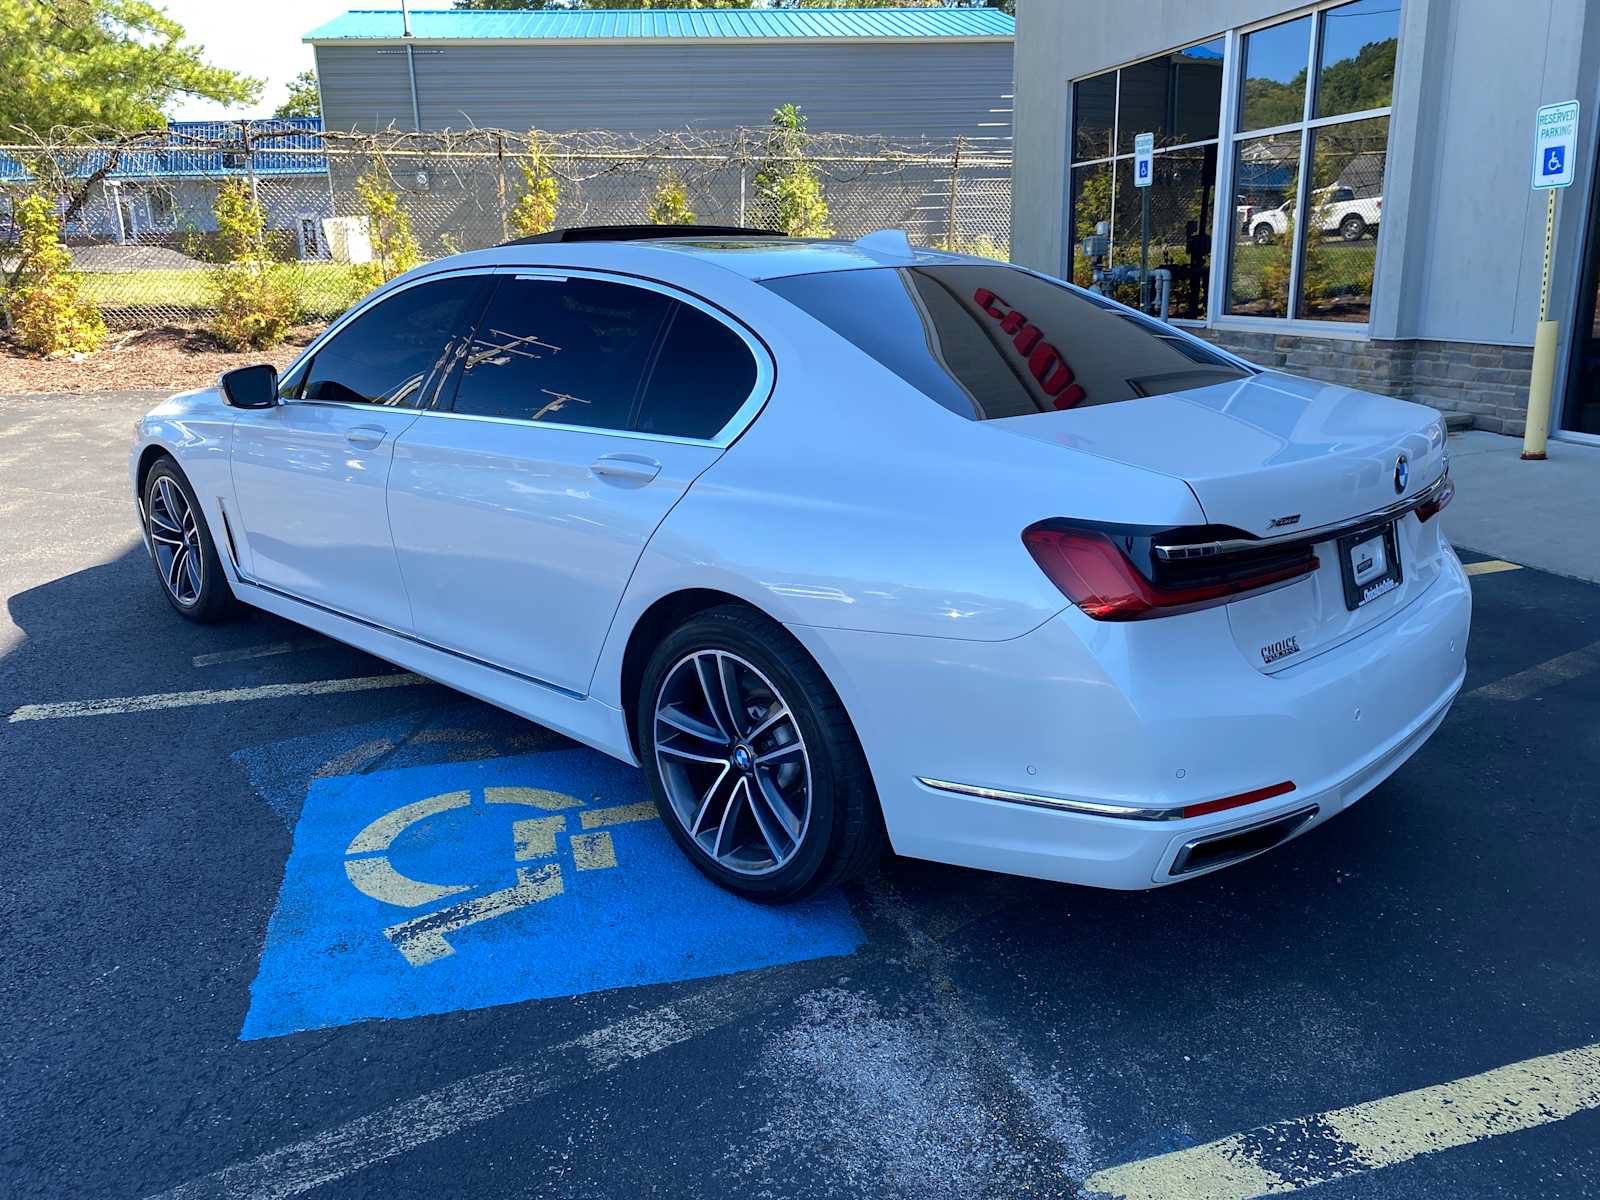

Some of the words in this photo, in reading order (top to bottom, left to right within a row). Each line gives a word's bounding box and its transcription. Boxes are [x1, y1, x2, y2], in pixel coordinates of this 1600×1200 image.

[1539, 110, 1575, 125] RESERVED
[1541, 124, 1572, 138] PARKING
[1261, 635, 1297, 657] CHOICE
